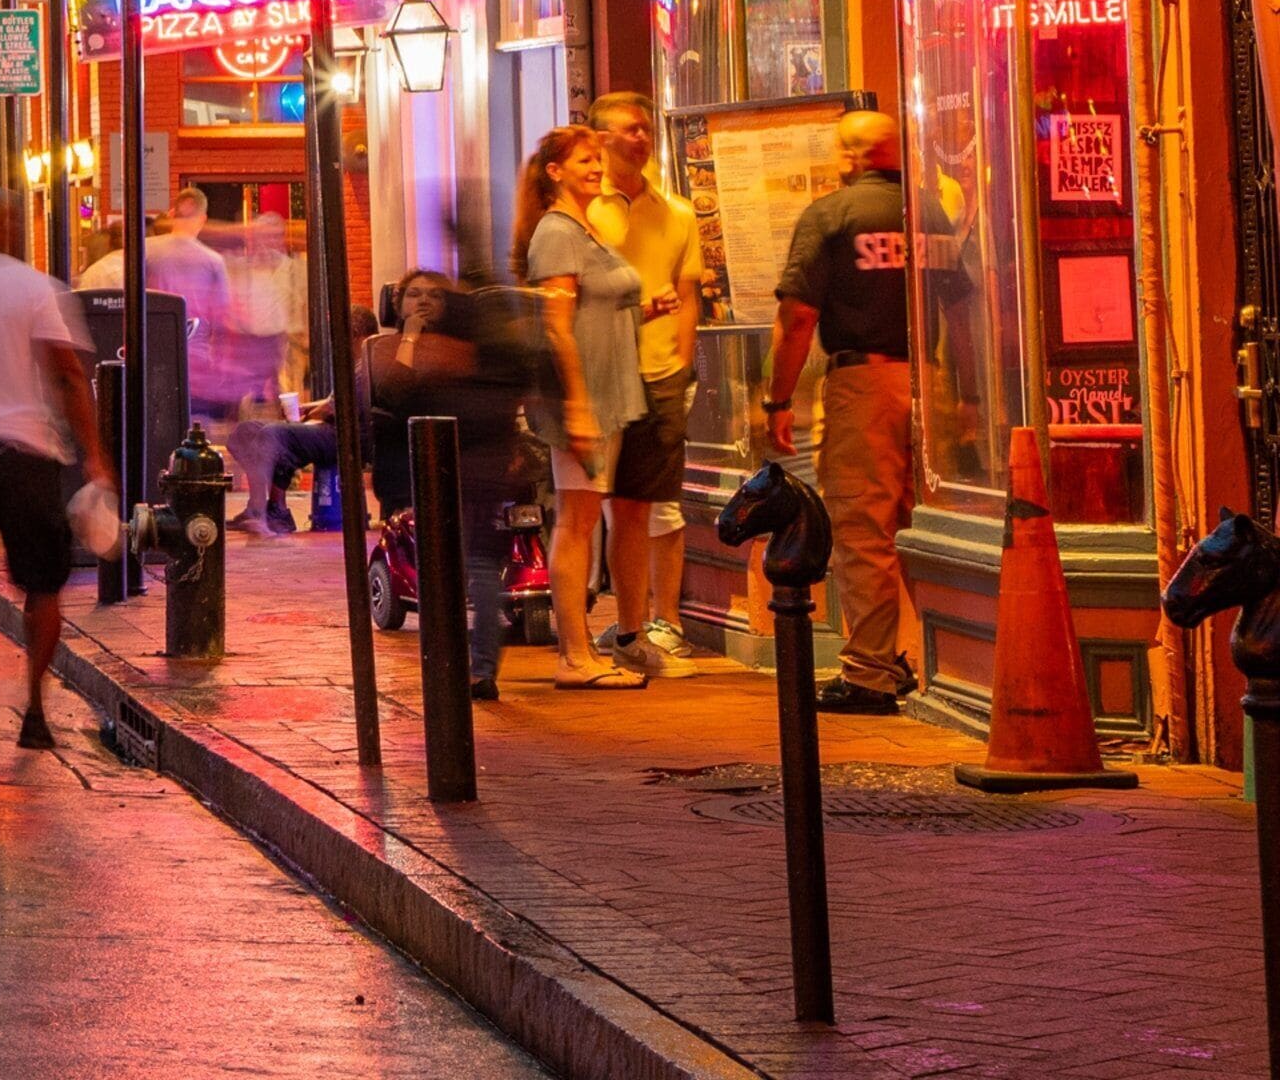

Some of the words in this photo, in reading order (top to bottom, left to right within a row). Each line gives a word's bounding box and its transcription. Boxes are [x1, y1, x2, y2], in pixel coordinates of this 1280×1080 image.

[231, 9, 256, 29] BY
[1044, 0, 1127, 25] MILLE
[1060, 368, 1129, 386] OYSTER
[1070, 384, 1124, 405] Named
